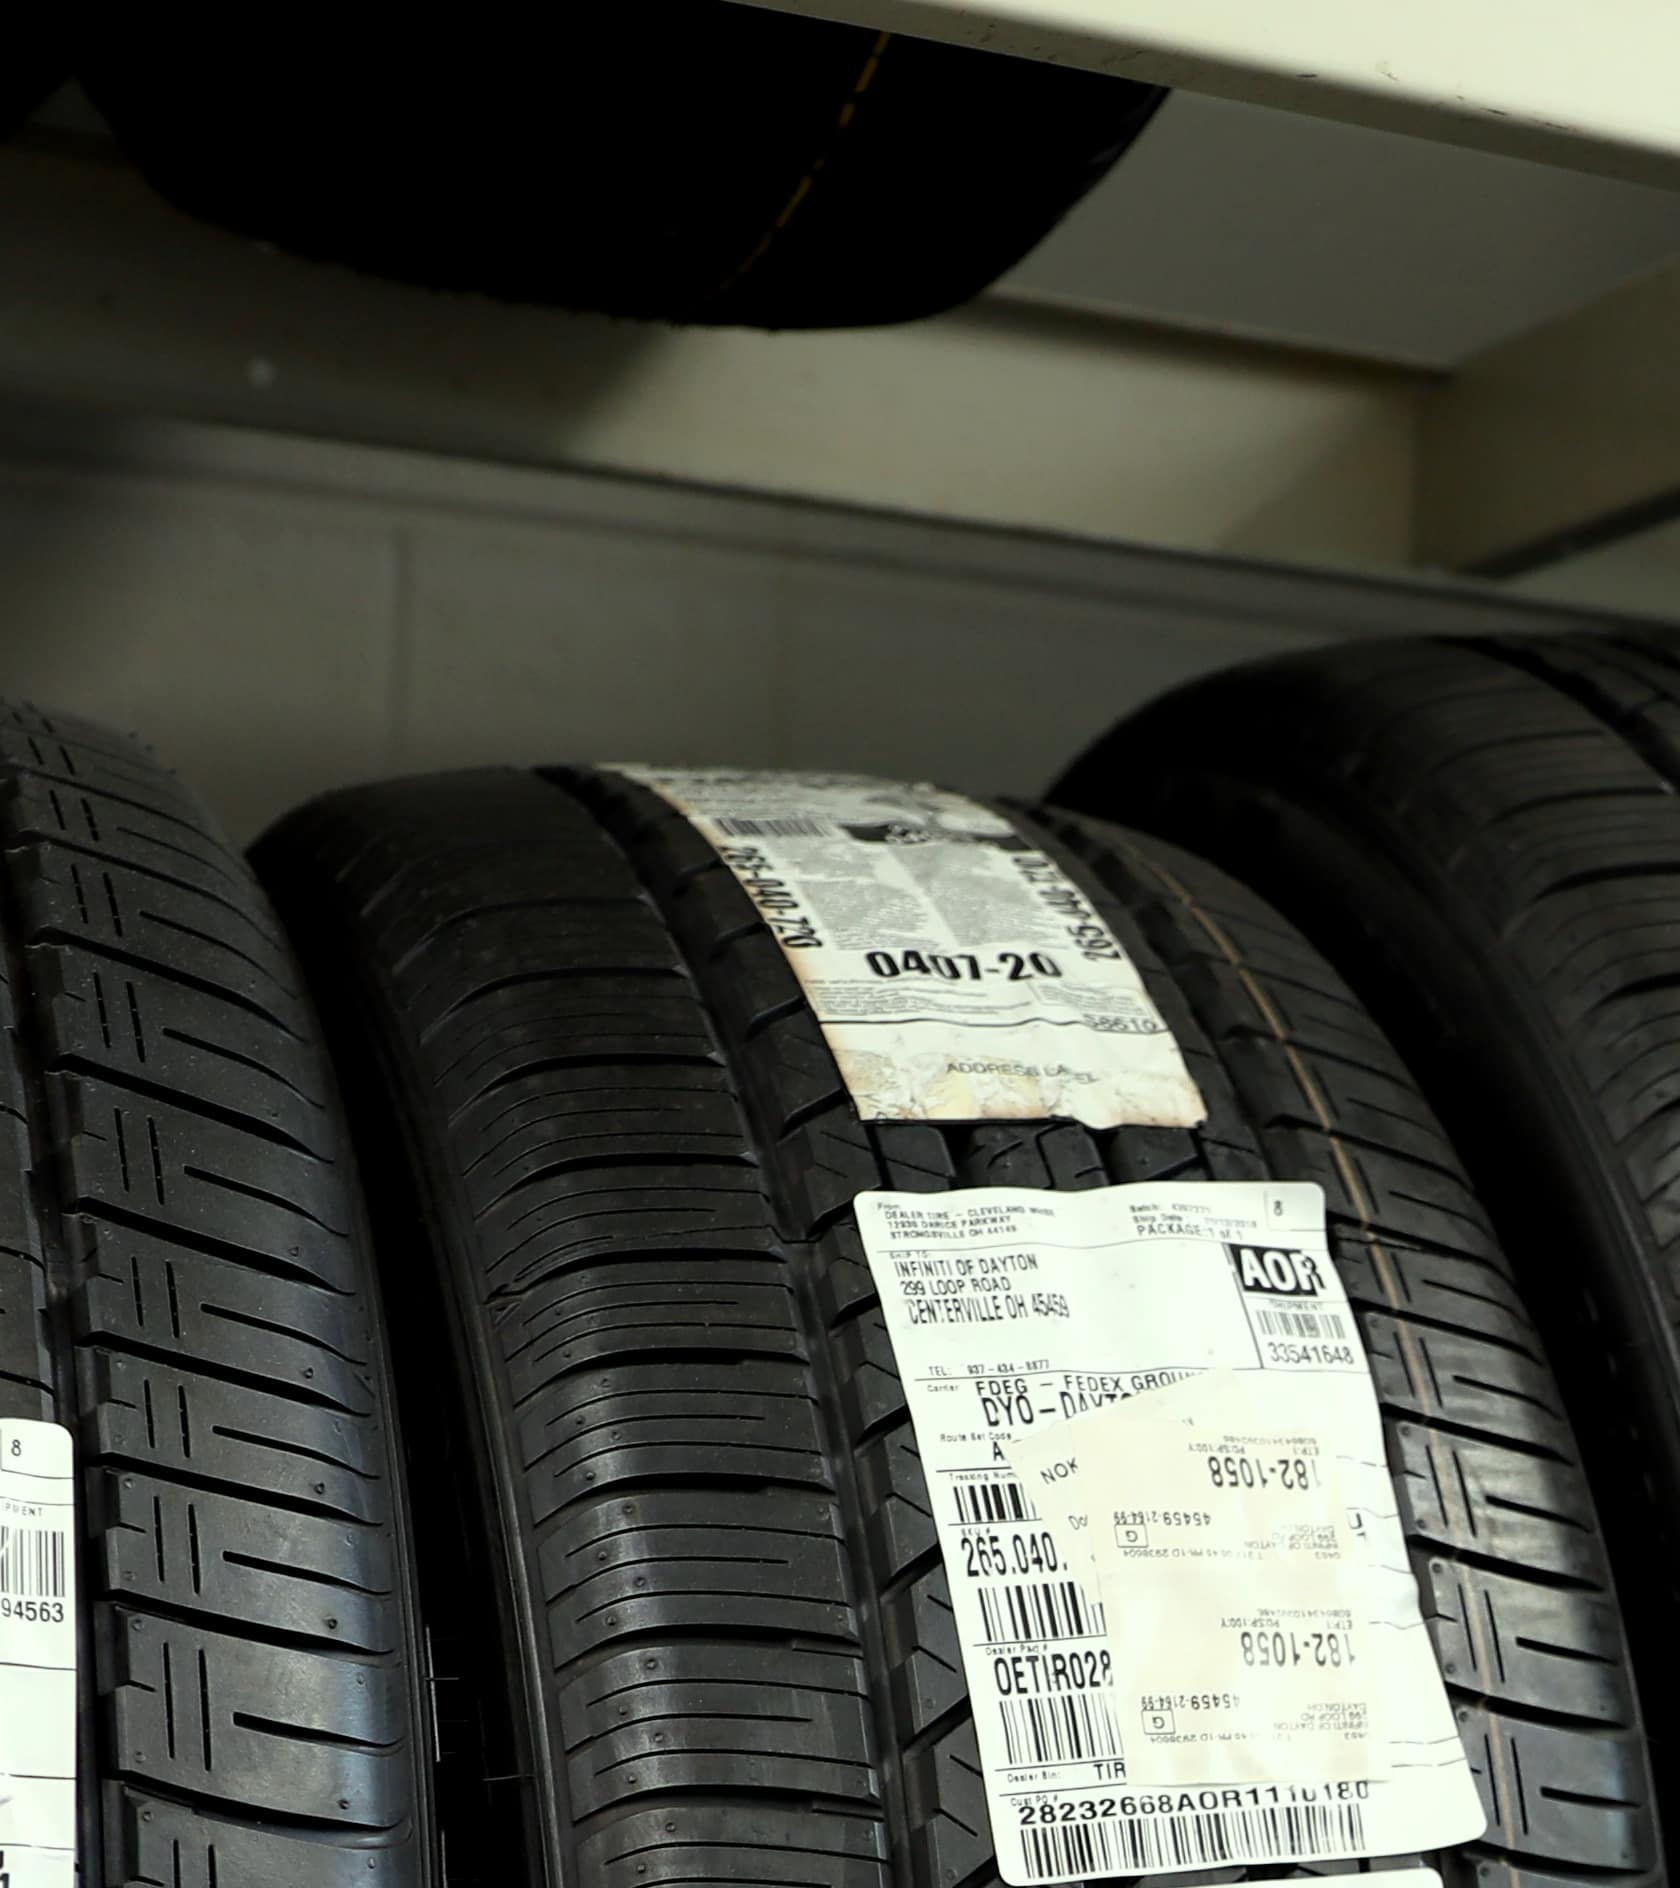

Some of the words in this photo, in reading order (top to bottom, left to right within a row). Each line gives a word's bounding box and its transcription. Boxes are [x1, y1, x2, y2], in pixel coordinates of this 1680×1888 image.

[864, 950, 1066, 981] 0407-20
[945, 1060, 1040, 1078] ADDRESS
[1273, 1200, 1284, 1217] 8
[894, 1259, 954, 1279] INFINITI
[956, 1257, 975, 1277] OF
[978, 1253, 1040, 1276] DAYTON
[1239, 1248, 1327, 1292] AOR
[899, 1280, 927, 1297] 299
[929, 1278, 966, 1297] LOOP
[971, 1275, 1013, 1293] ROAD
[905, 1295, 1005, 1326] CENTERVILLE
[1006, 1294, 1029, 1320] OH
[1267, 1341, 1355, 1366] 33541648
[974, 1378, 1029, 1397] FDEG
[1063, 1373, 1122, 1393] FEDEX
[980, 1395, 1035, 1428] DYO
[10, 1438, 22, 1457] 8
[1207, 1456, 1322, 1490] 182-1058
[1125, 1529, 1139, 1543] G
[1240, 1631, 1356, 1667] 182-1058
[1151, 1715, 1166, 1730] G
[1093, 1761, 1127, 1781] TIR
